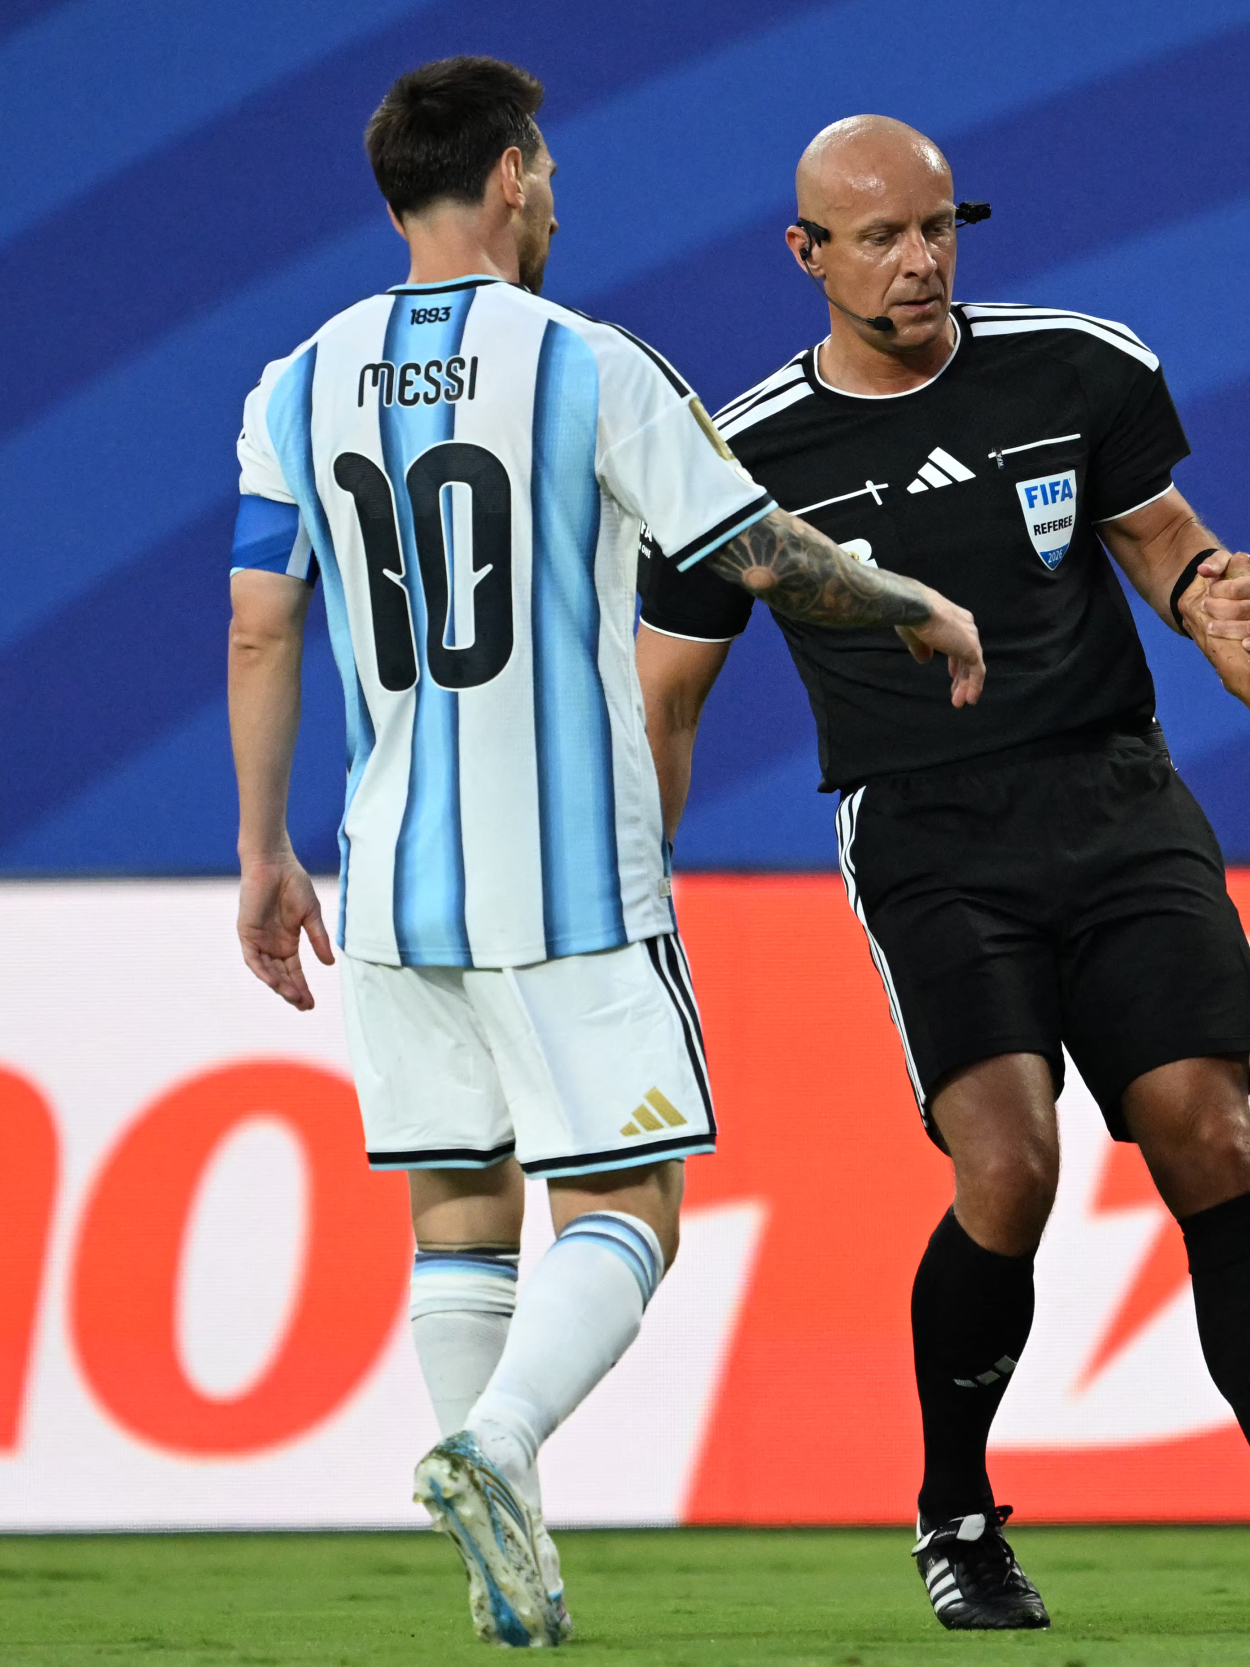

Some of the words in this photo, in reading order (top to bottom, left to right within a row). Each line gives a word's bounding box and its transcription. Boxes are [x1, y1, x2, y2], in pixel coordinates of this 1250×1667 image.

[410, 306, 453, 325] 1893
[357, 355, 479, 408] MESSI
[1024, 478, 1074, 509] FIFA
[1033, 515, 1073, 536] REFEREE
[332, 441, 514, 692] 10
